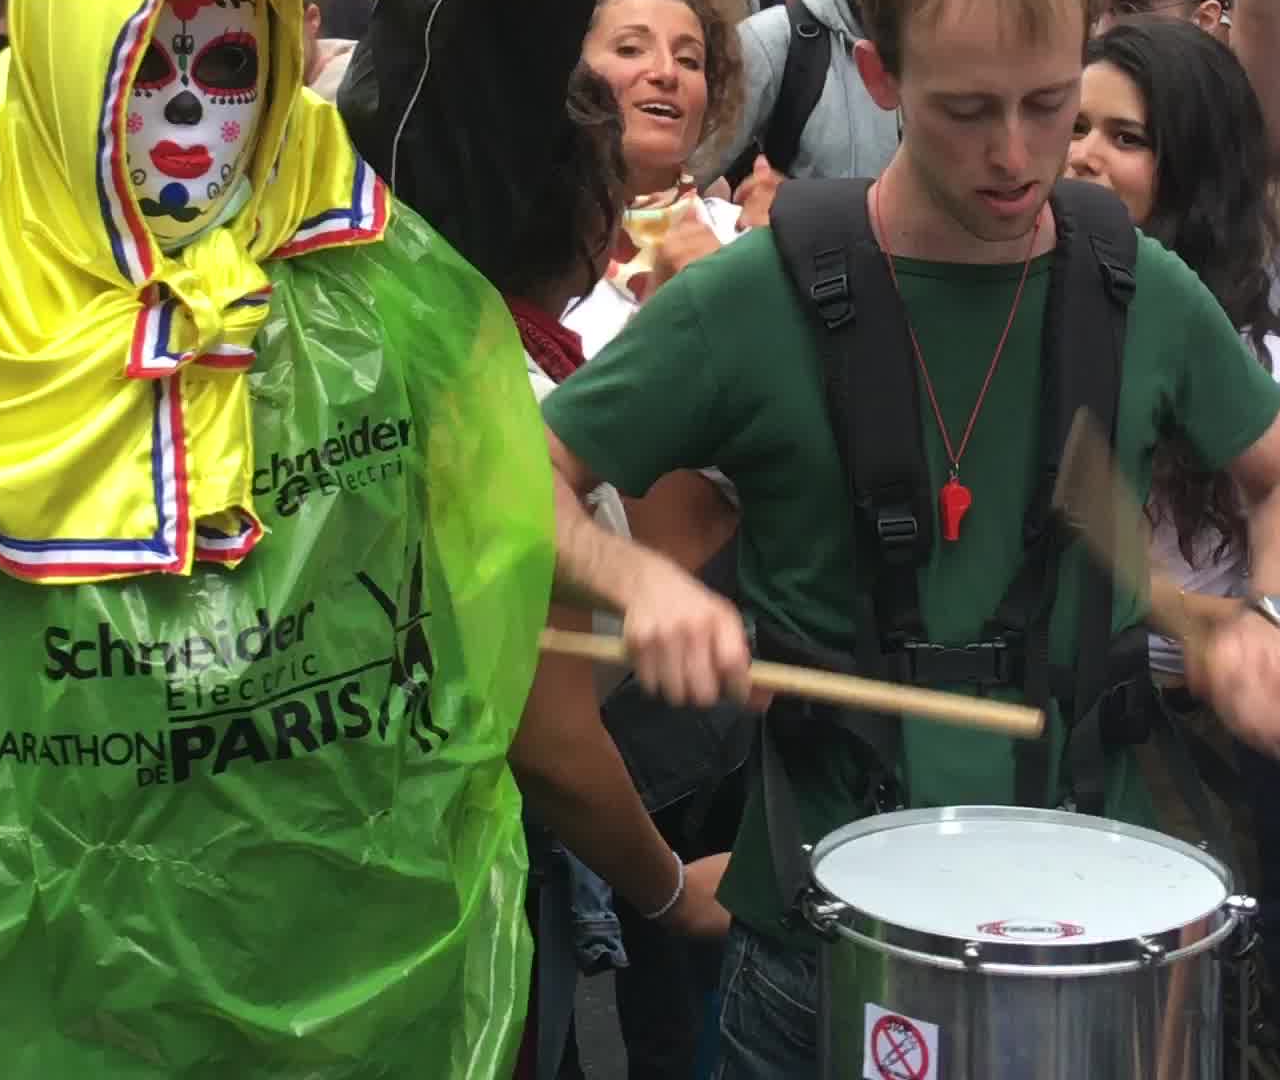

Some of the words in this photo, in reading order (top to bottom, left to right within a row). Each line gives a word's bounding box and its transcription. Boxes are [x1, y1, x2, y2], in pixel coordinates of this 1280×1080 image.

[251, 415, 412, 496] chneider
[44, 600, 315, 680] Schneider
[166, 654, 318, 711] Electric
[135, 764, 169, 788] DE
[170, 680, 371, 783] PARIS
